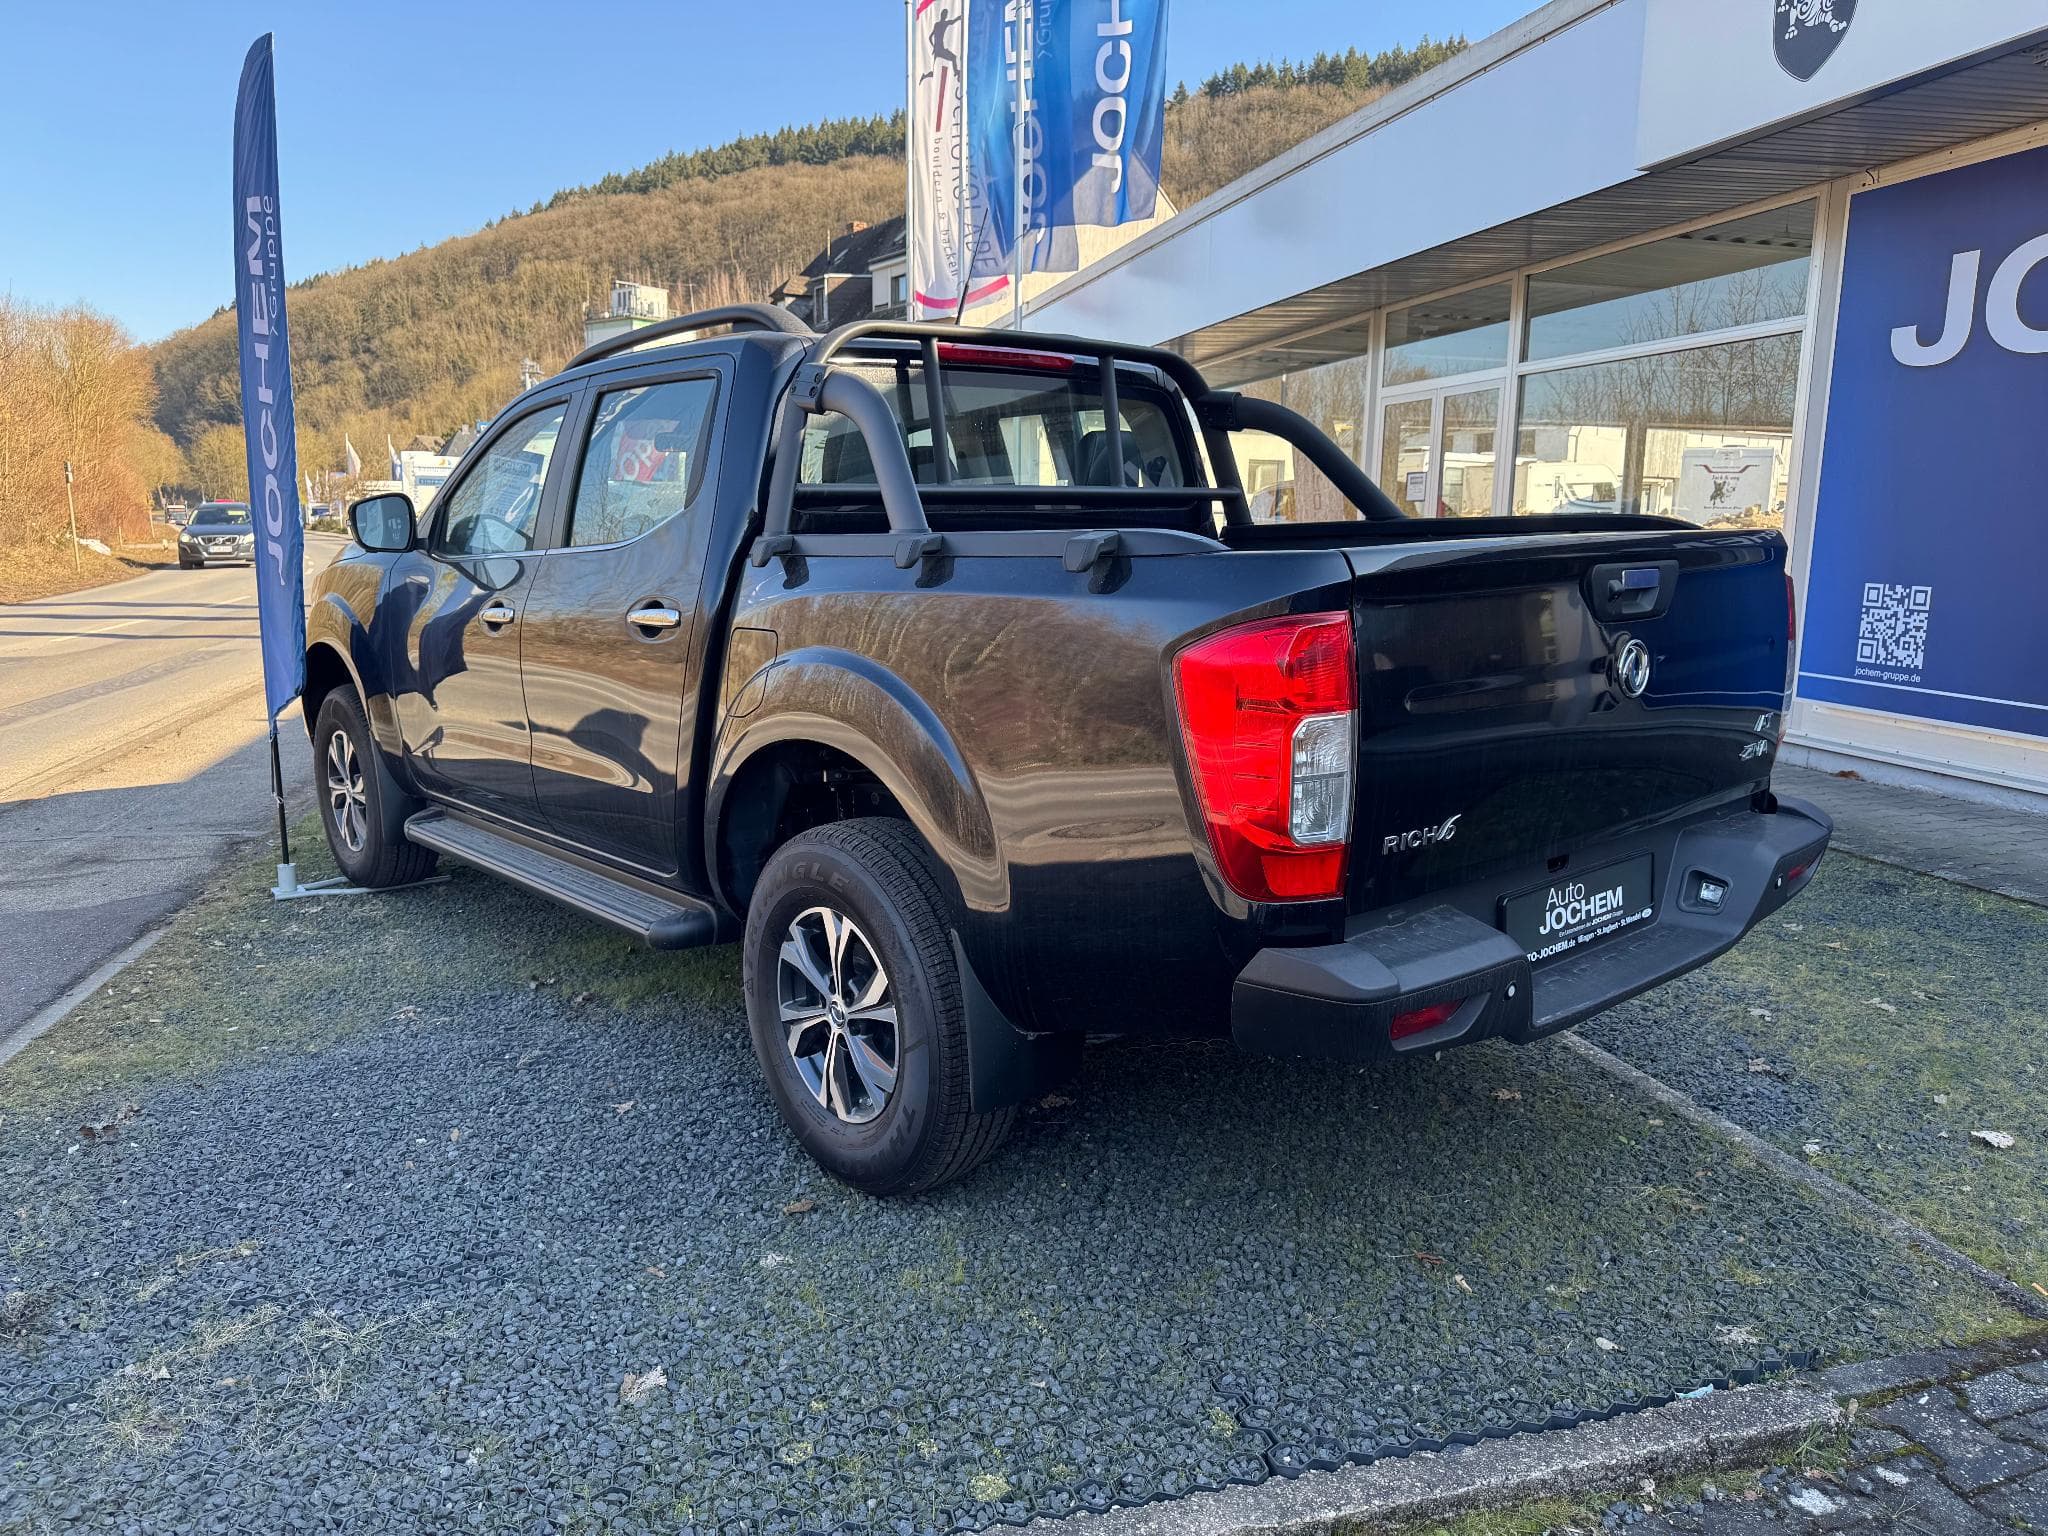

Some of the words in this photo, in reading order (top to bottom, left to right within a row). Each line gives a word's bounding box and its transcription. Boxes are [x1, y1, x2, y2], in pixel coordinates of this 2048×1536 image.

[247, 196, 286, 586] JOCHEM
[1854, 666, 1921, 683] jochem-gruppe.de
[1539, 886, 1623, 935] JOCHEM
[1545, 882, 1585, 910] Auto
